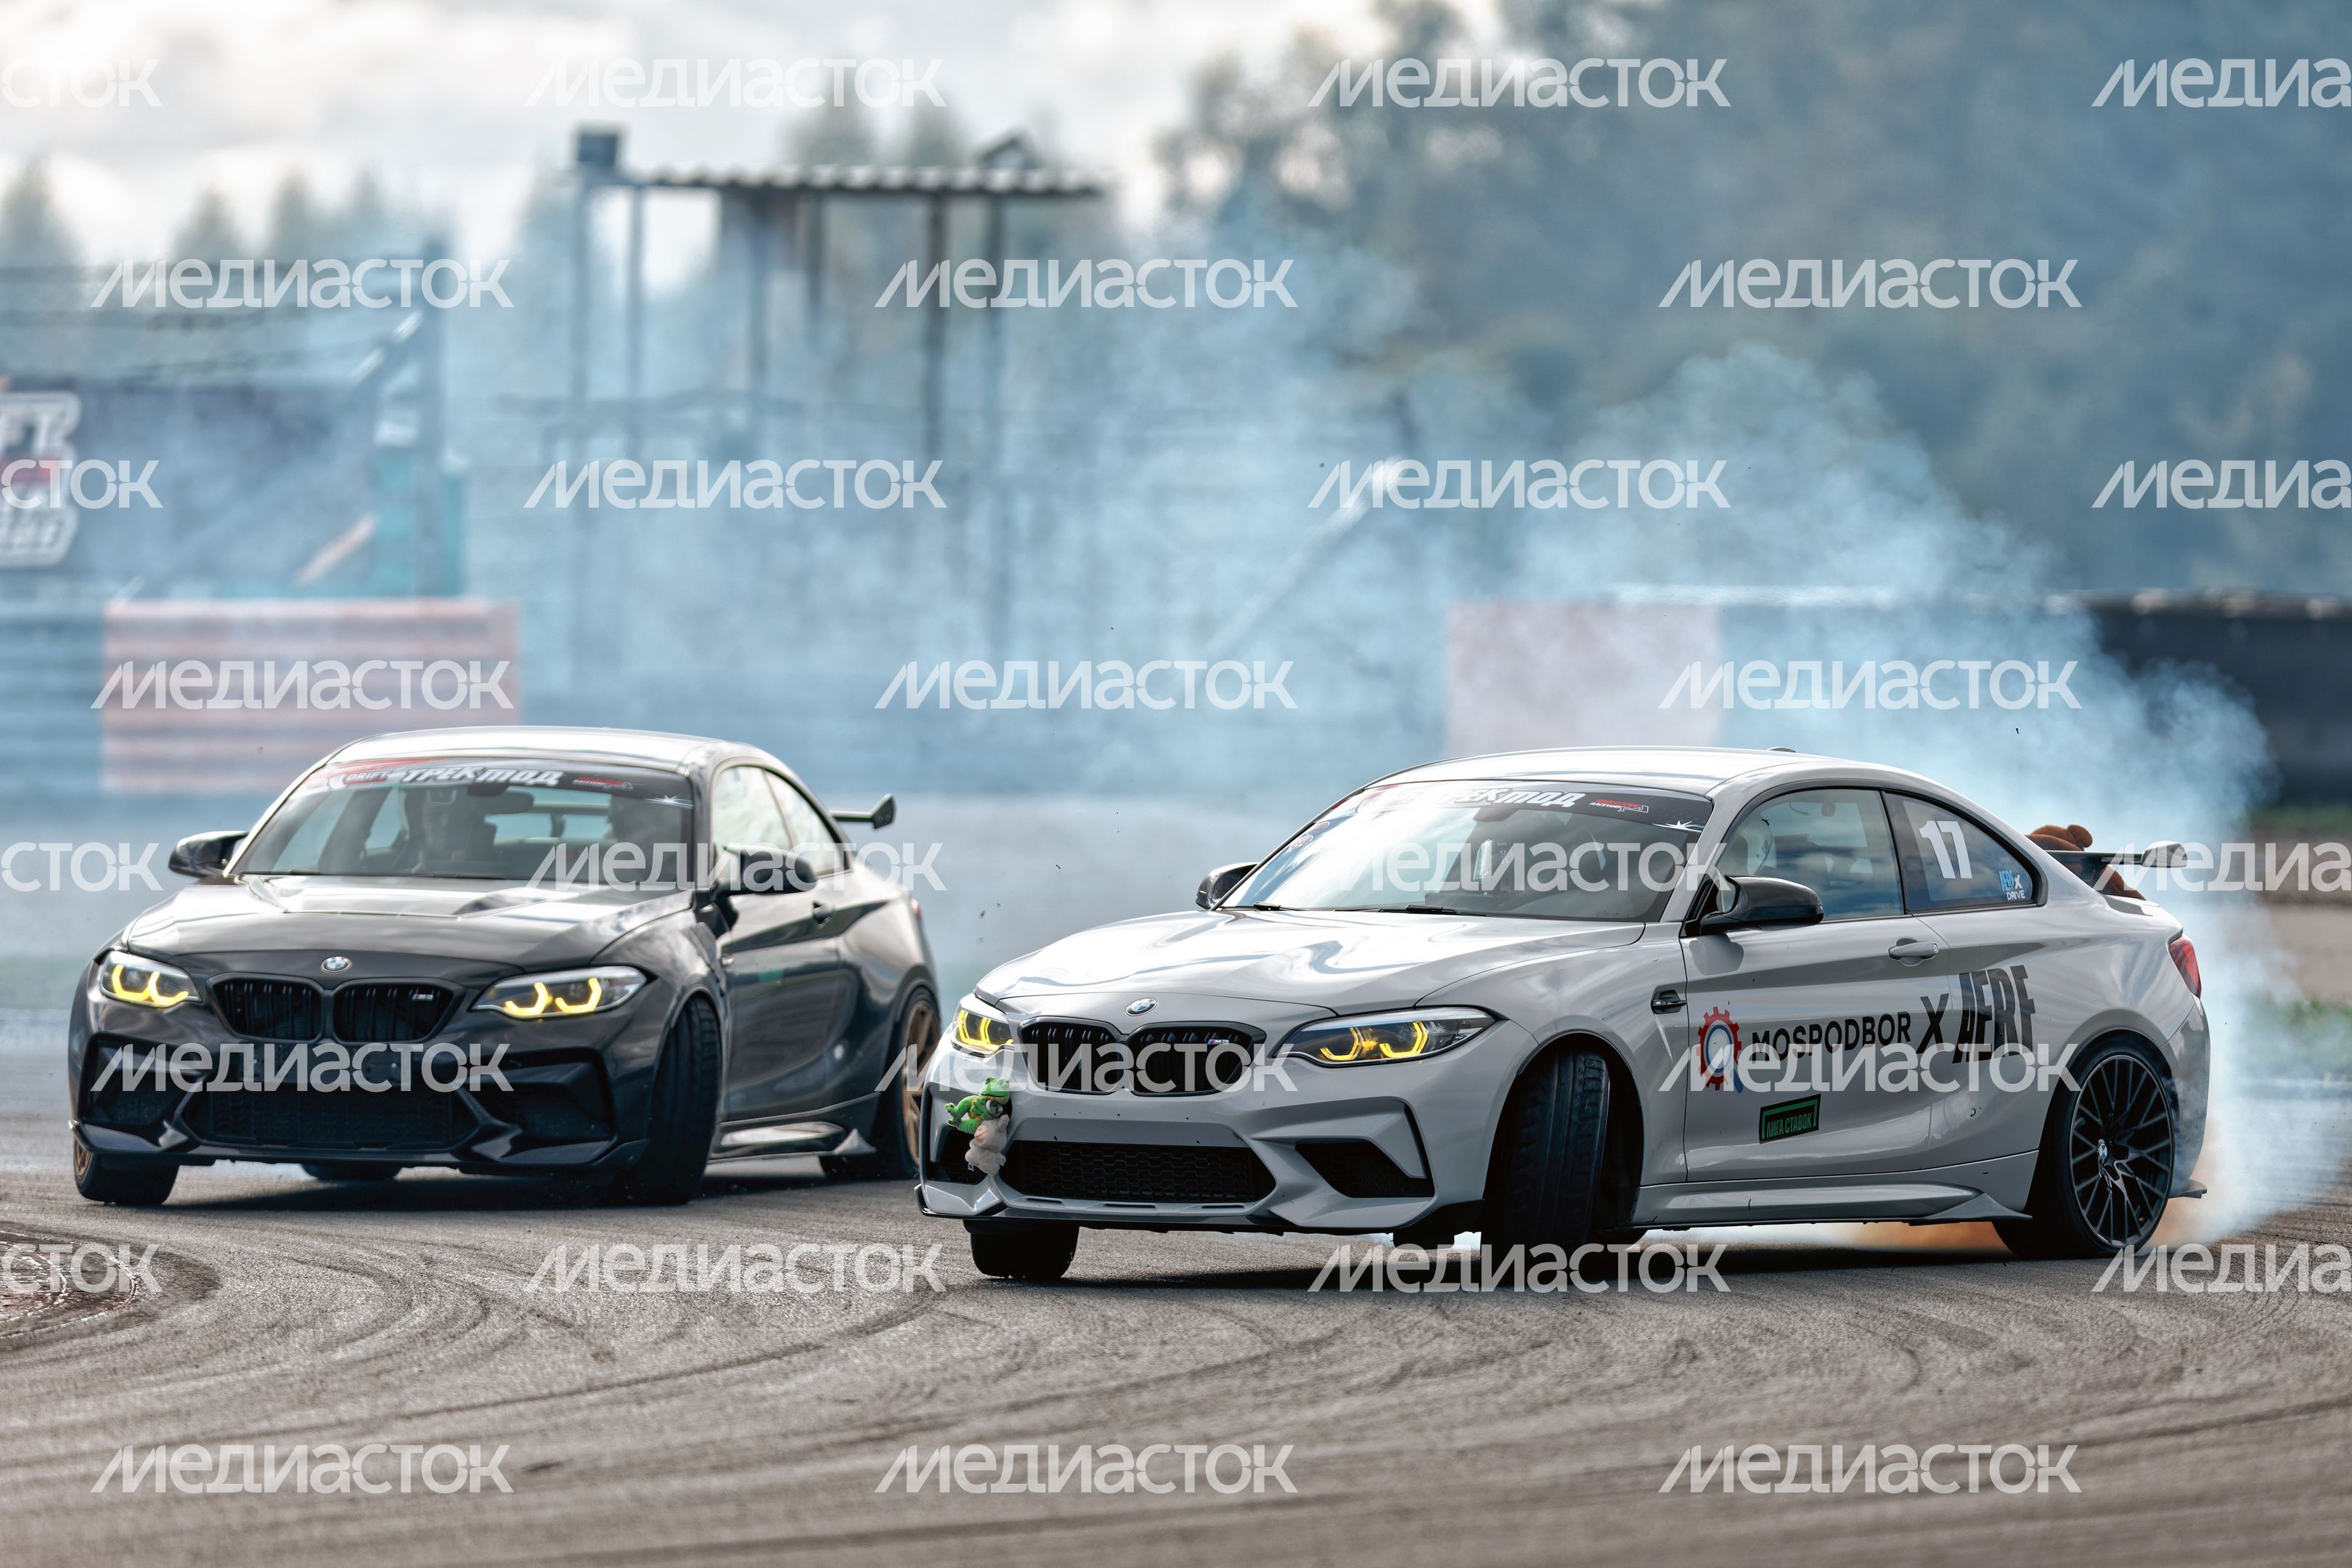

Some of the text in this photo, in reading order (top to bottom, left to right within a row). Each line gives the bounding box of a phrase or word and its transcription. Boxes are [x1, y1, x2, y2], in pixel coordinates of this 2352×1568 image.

[1919, 820, 1972, 878] 17
[2006, 890, 2025, 900] DRIVE
[1752, 1011, 1911, 1063] MOSPODBOR
[1916, 993, 1949, 1054] X
[1766, 1112, 1813, 1138] ЛИГА СТАВОК
